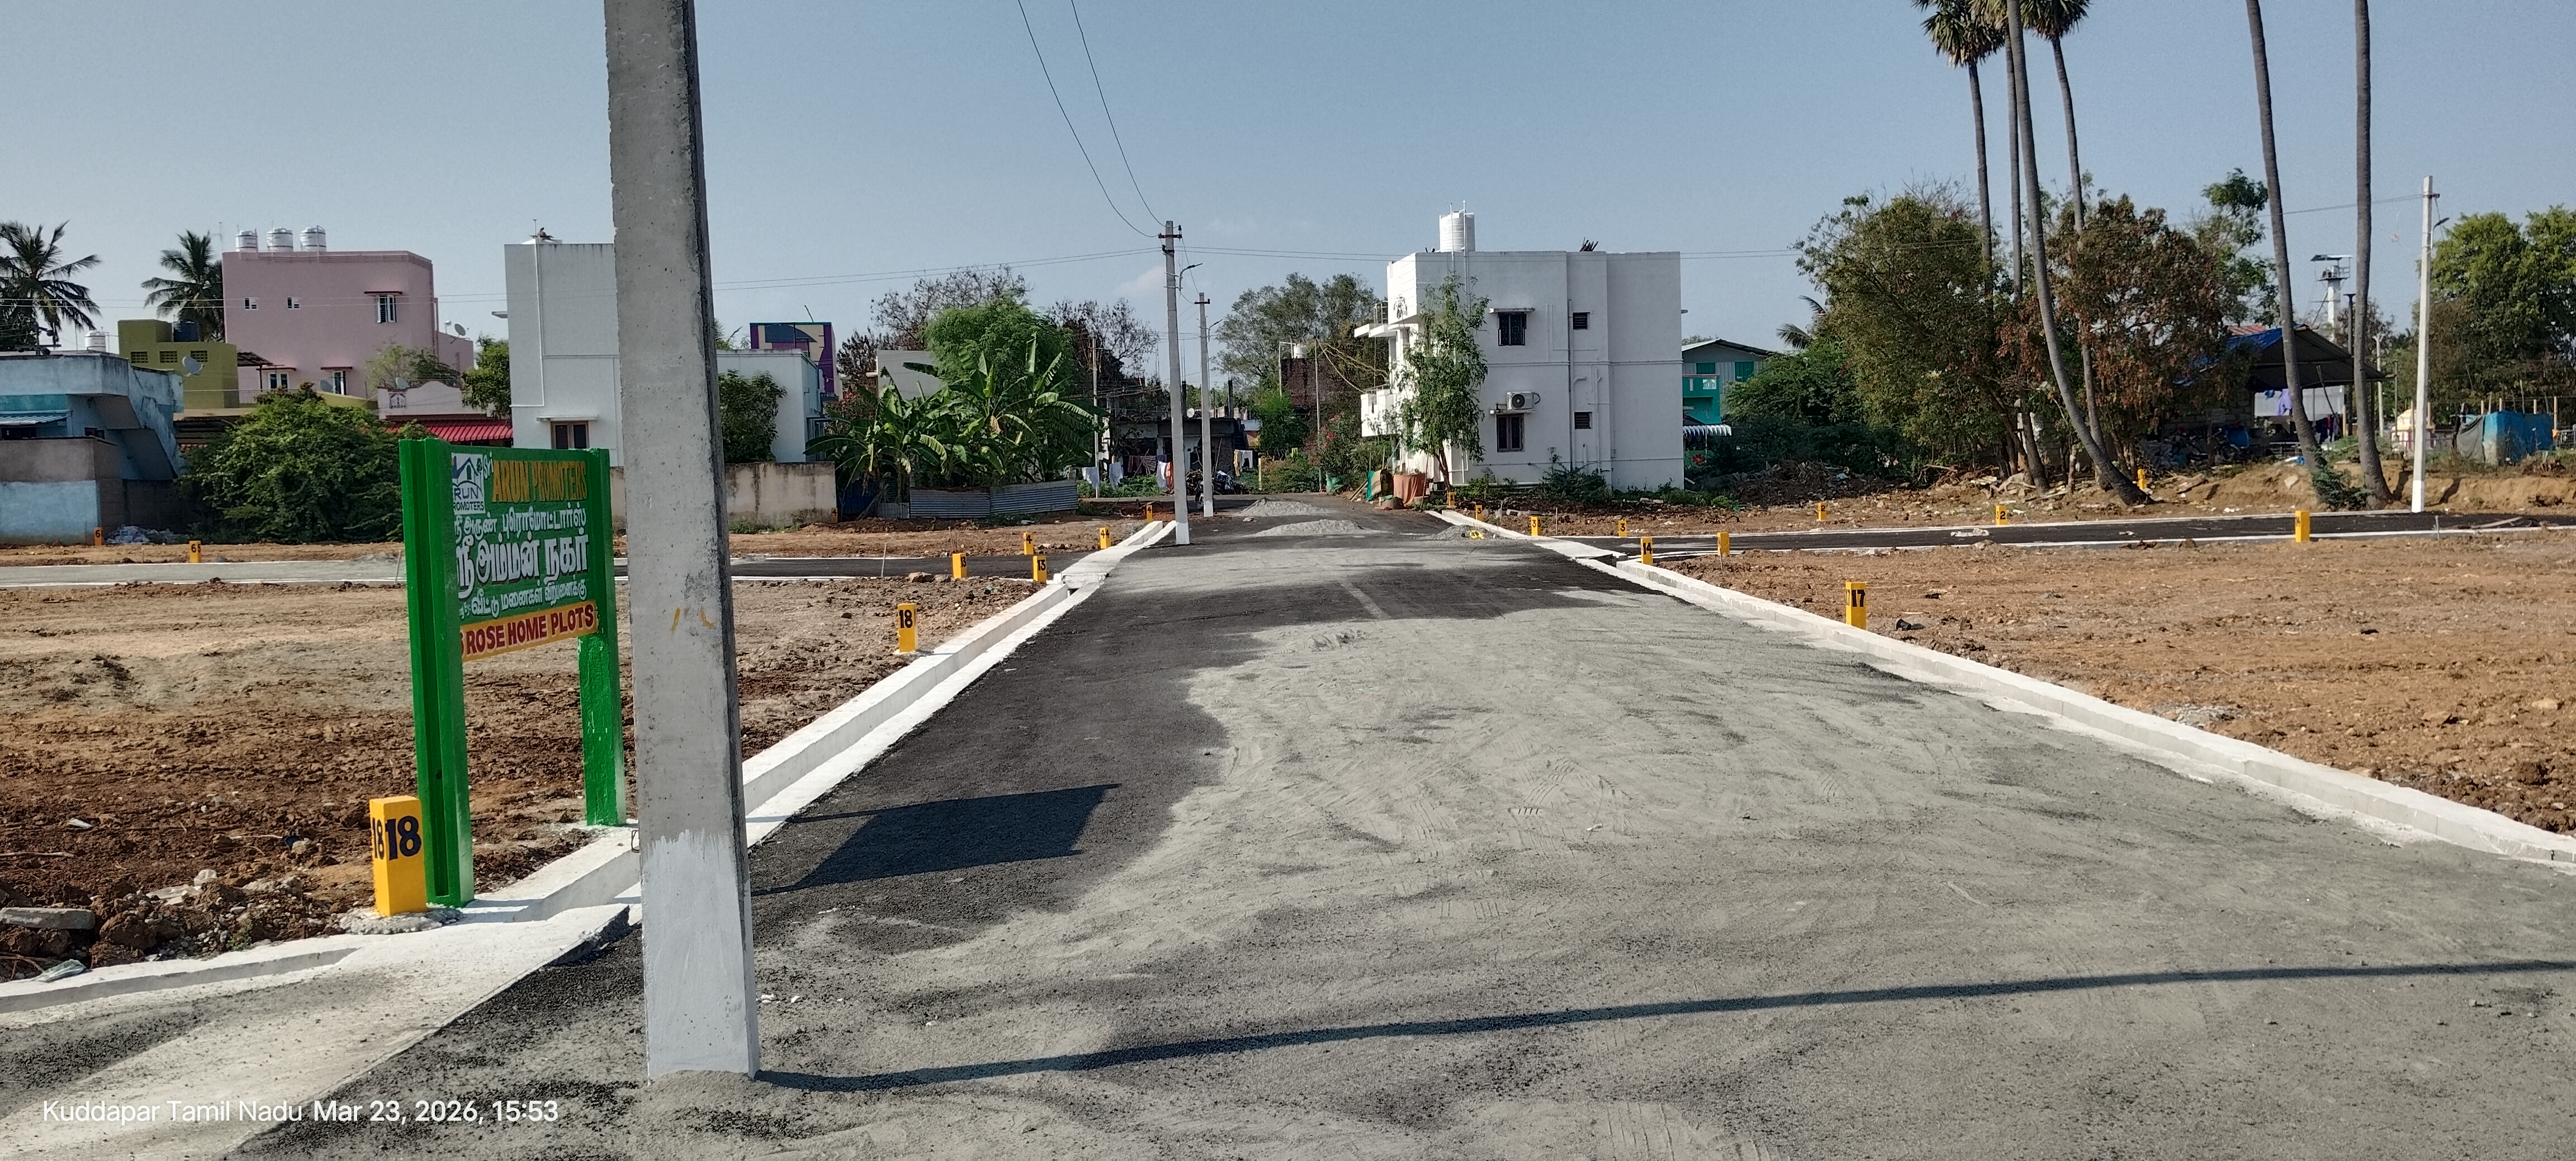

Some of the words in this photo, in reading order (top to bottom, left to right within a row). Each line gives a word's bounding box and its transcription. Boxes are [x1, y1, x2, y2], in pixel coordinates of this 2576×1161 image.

[484, 450, 494, 479] Sri
[493, 460, 530, 502] ARUN
[532, 460, 587, 501] PROMOTERS
[454, 487, 479, 501] RUN
[453, 501, 484, 511] ROMOTERS
[1026, 535, 1032, 544] 4
[1101, 530, 1105, 539] 4
[1106, 530, 1110, 538] 4
[476, 531, 540, 583] அம்மன்
[544, 527, 589, 585] நகர்
[1643, 542, 1652, 555] 14
[960, 556, 966, 568] 13
[1038, 560, 1045, 570] 13
[471, 587, 499, 617] வீட்டு
[1852, 589, 1865, 607] 17
[899, 610, 913, 628] 18
[466, 625, 505, 654] ROSE
[508, 615, 547, 645] HOME
[551, 604, 594, 636] PLOTS
[372, 817, 385, 860] 18
[385, 815, 422, 861] 18
